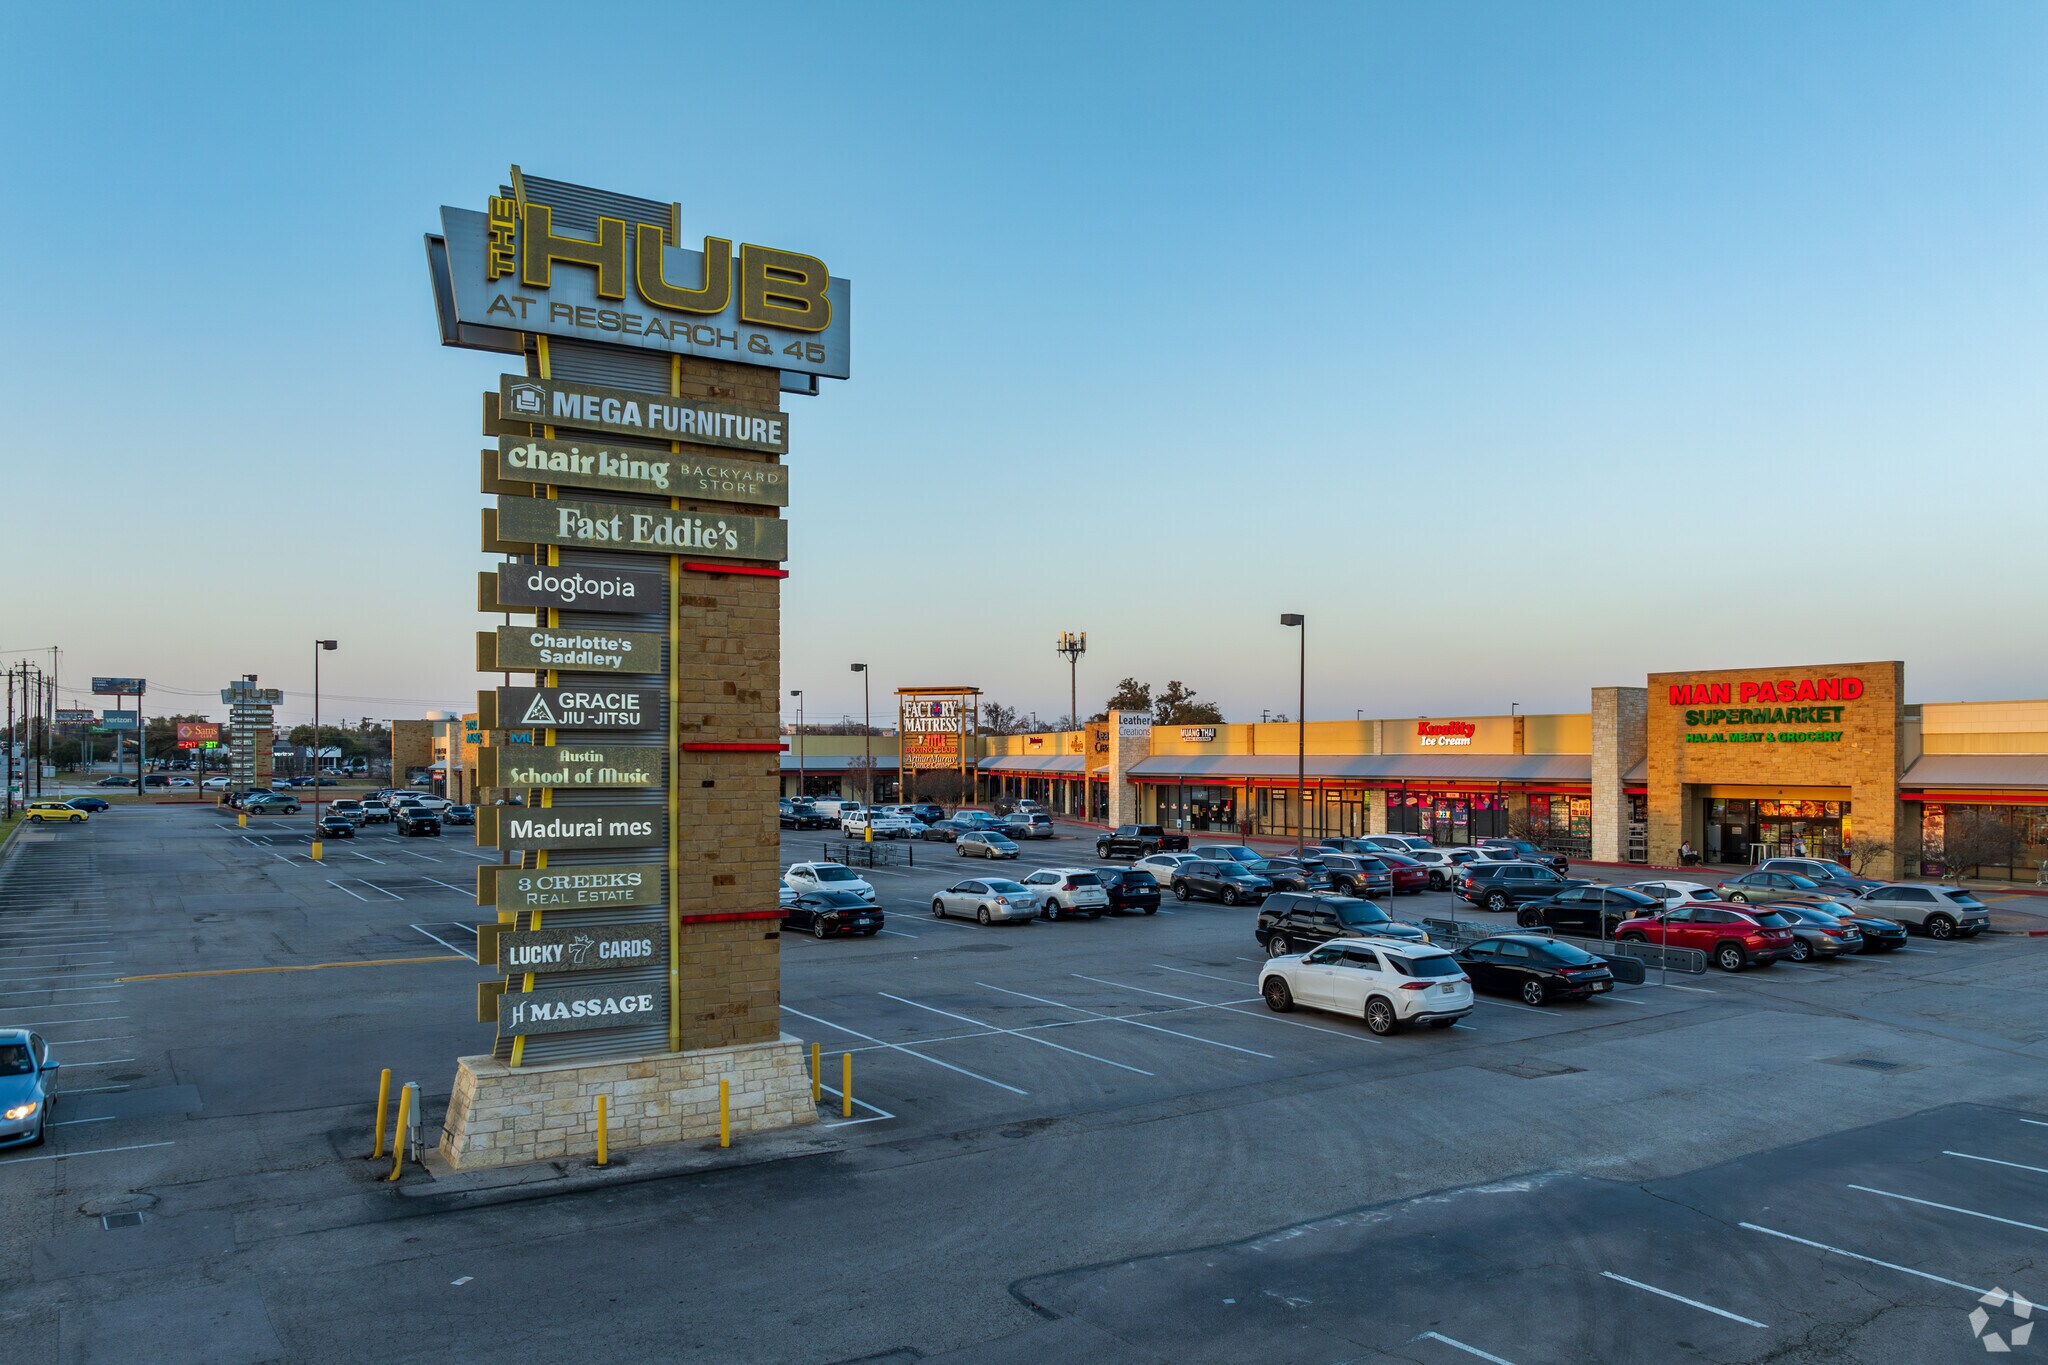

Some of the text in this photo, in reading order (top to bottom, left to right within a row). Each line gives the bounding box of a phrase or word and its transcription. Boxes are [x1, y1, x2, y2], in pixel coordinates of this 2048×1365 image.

[487, 195, 516, 281] THE
[522, 202, 832, 333] HUB
[487, 294, 827, 364] AT RESEARCH & 45
[553, 391, 782, 445] MEGA FURNITURE
[681, 465, 779, 484] BACKYARD
[699, 479, 757, 494] STORE
[556, 507, 738, 551] Fast Eddie's
[527, 571, 635, 602] dogtopia
[530, 632, 632, 651] Charlotte's
[540, 650, 622, 669] Saddlery
[232, 688, 280, 699] HUB
[1669, 677, 1864, 705] MAN PASAND
[558, 692, 640, 710] GRACIE
[905, 718, 958, 732] MATTRESS
[1119, 715, 1151, 725] Leather
[1685, 705, 1845, 726] SUPERMARKET
[1119, 727, 1151, 736] Creations
[1201, 729, 1215, 737] THAI
[1417, 721, 1475, 737] Kwality
[1685, 731, 1844, 743] HALAL MEAT & GROCERY
[926, 734, 946, 746] TITLE
[1421, 736, 1471, 746] Ice Cream
[559, 750, 603, 762] Austin
[510, 768, 650, 784] School of Music
[510, 818, 652, 839] Madurai mes
[518, 872, 642, 891] 3 CREEKS
[527, 889, 634, 905] REAL ESTATE
[510, 944, 563, 965] LUCKY
[599, 939, 652, 959] CARDS
[530, 994, 654, 1022] MASSAGE
